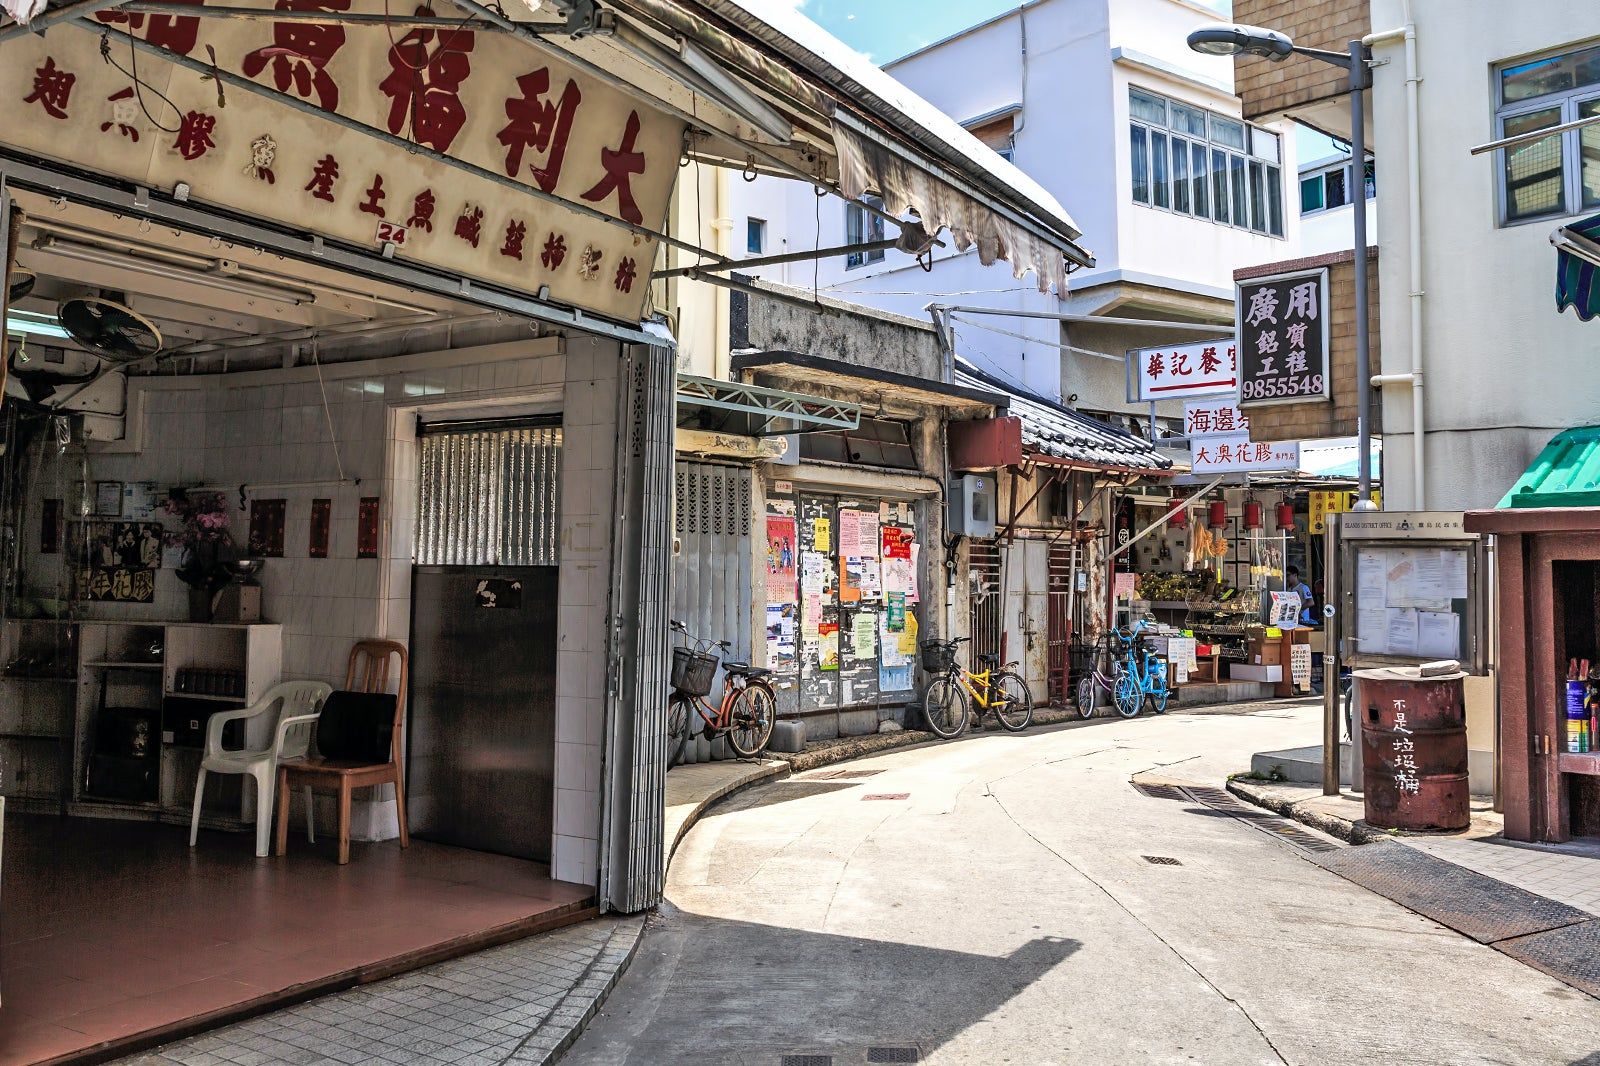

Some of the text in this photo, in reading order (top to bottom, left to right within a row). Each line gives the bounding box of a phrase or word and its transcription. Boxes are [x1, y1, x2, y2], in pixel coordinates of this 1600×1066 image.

[378, 223, 405, 245] 24
[1242, 374, 1323, 400] 9855548
[1194, 442, 1273, 465] 大澳花膠
[1417, 521, 1464, 529] 離島民政事
